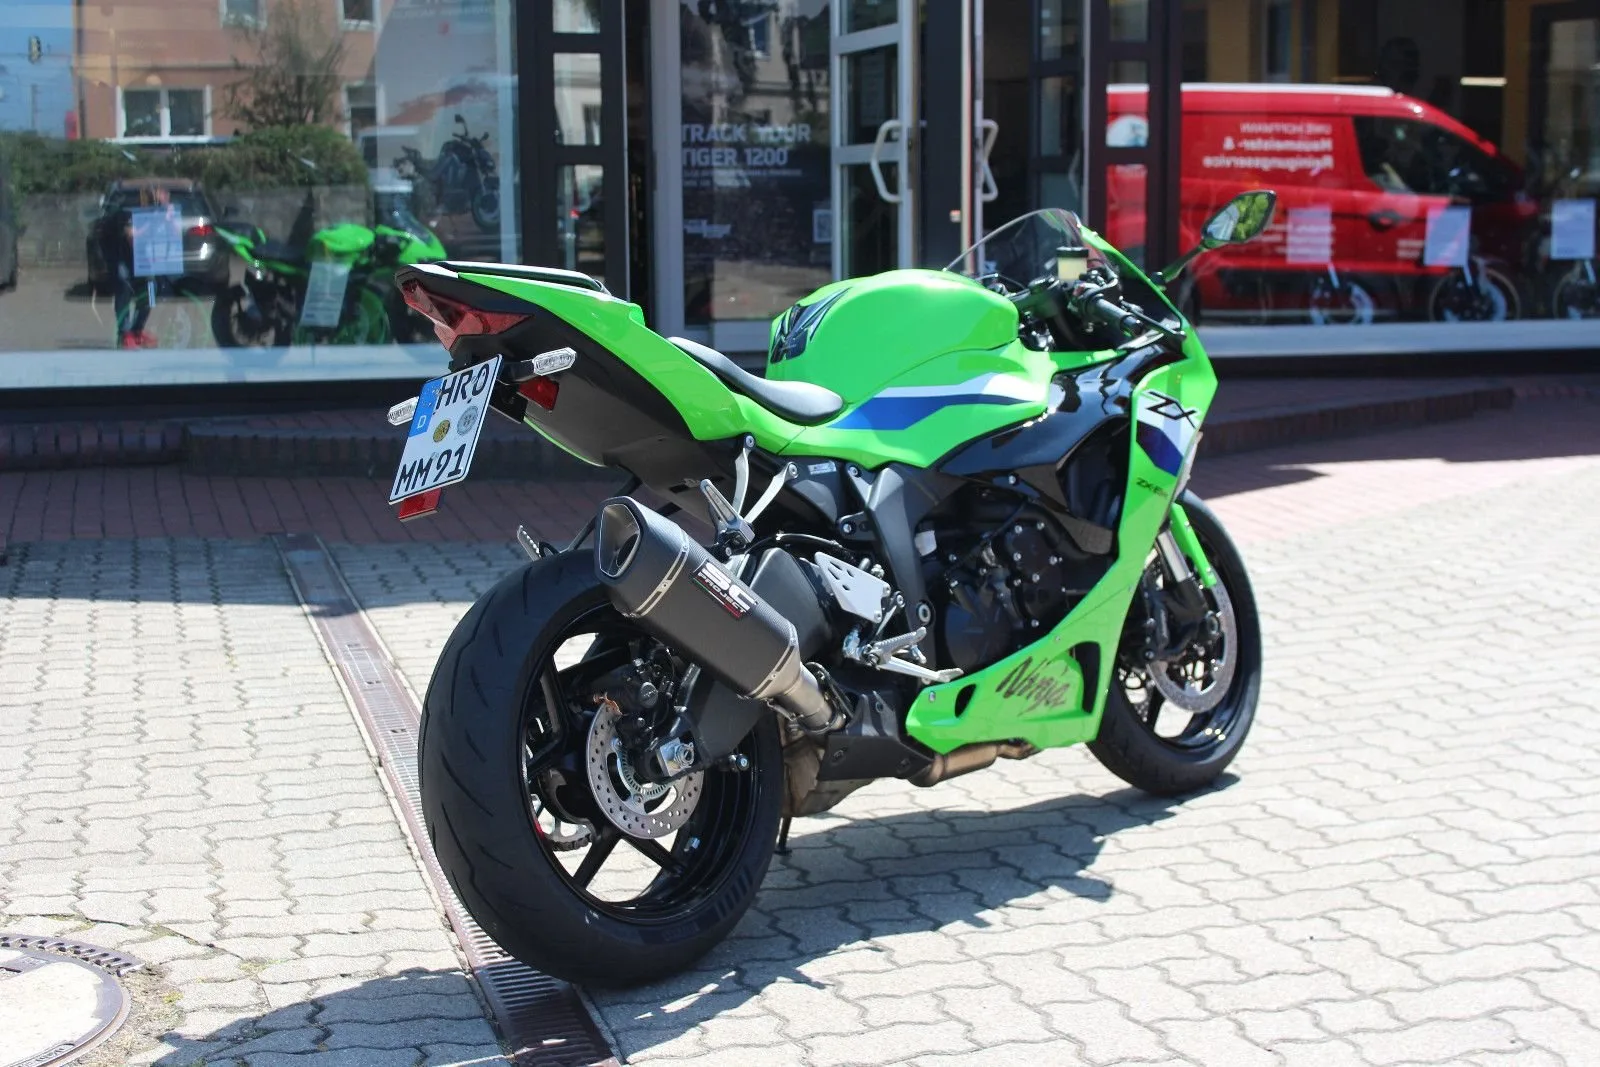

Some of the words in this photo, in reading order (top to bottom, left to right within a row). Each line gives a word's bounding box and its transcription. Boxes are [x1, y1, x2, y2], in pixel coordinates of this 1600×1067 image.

[682, 123, 746, 142] TRACK
[757, 123, 811, 142] YOUR
[682, 147, 738, 166] TIGER
[745, 147, 789, 166] 1200
[436, 363, 490, 410] HRO
[416, 415, 428, 430] D
[1145, 391, 1198, 430] ZX
[697, 571, 747, 614] PROJECT
